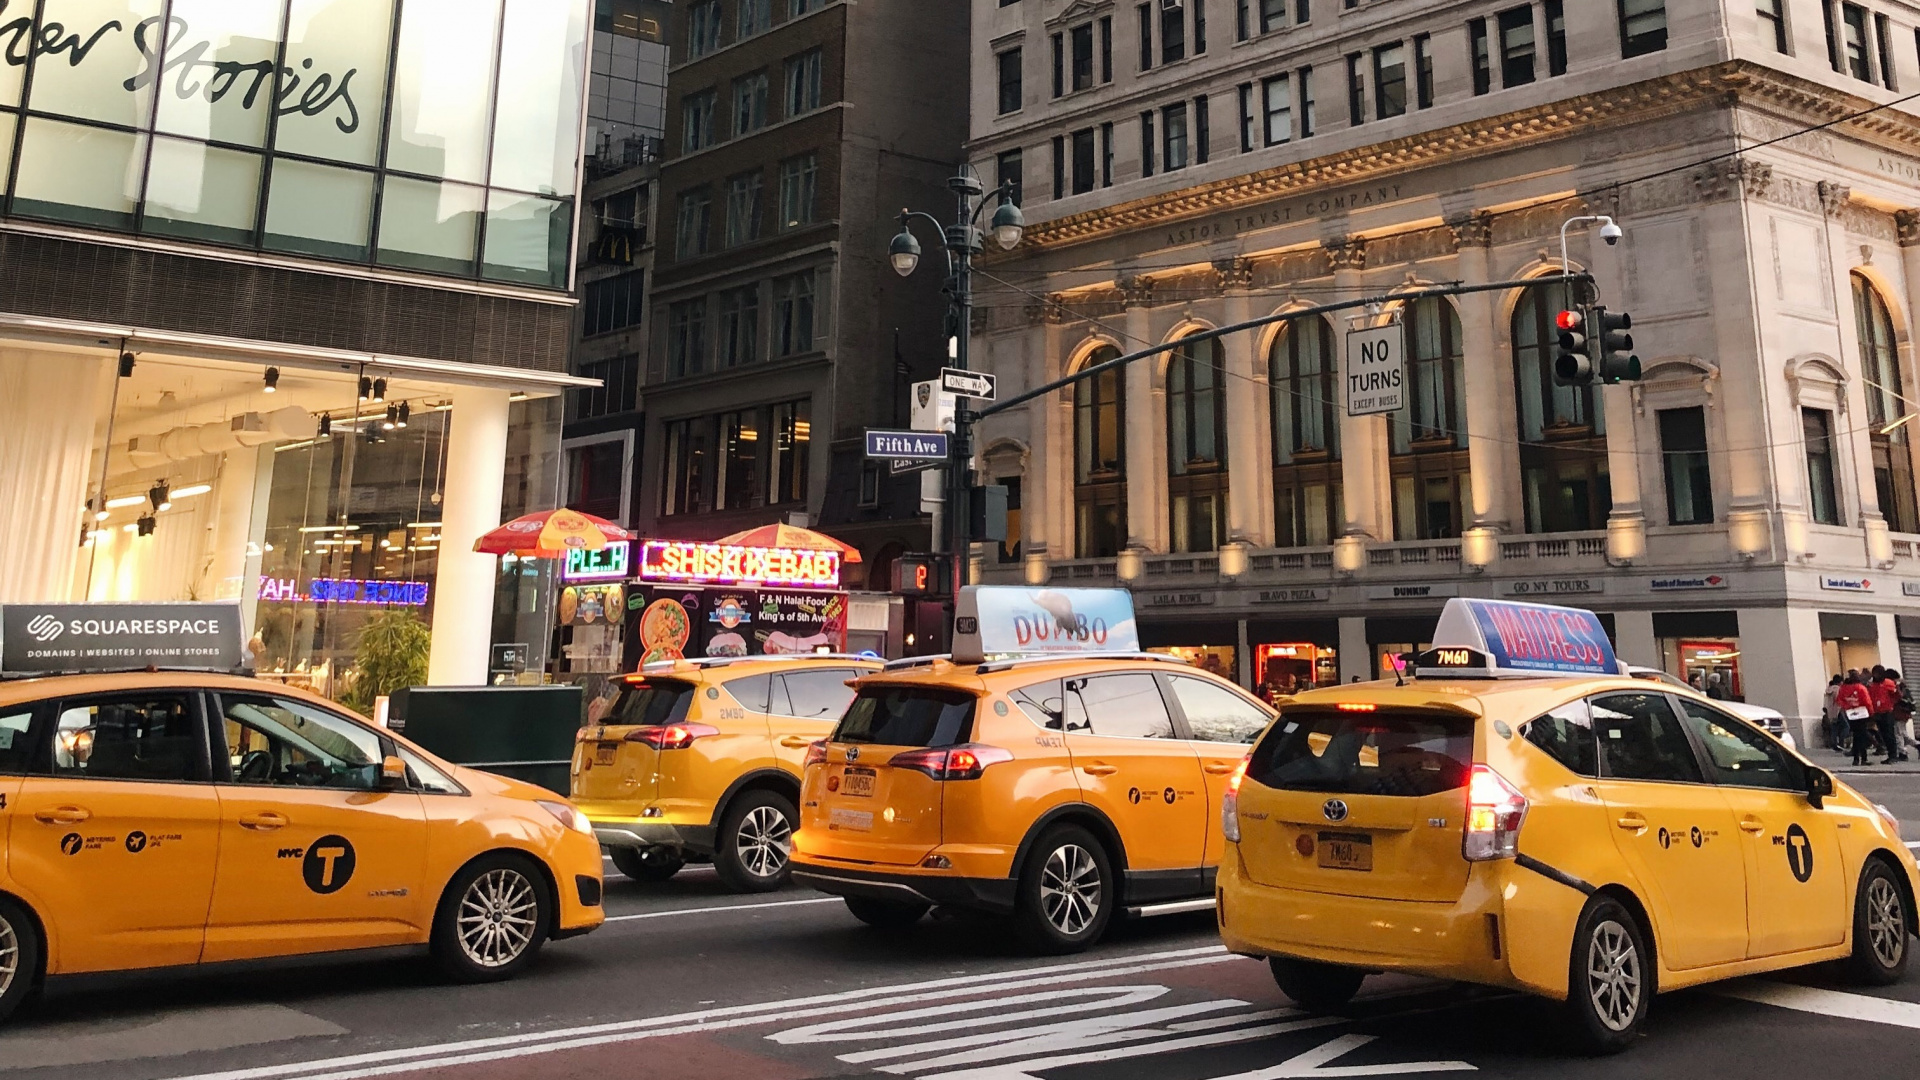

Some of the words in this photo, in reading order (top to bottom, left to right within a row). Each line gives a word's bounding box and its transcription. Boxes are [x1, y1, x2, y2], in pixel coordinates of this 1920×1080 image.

[123, 16, 359, 134] Stories
[1166, 223, 1222, 245] ASTOR
[1305, 185, 1402, 216] COMPANY
[1361, 339, 1389, 365] NO
[949, 376, 965, 388] ONE
[971, 380, 988, 391] WAY
[1350, 368, 1401, 393] TURNS
[1354, 398, 1375, 410] EXCEPT
[1379, 395, 1398, 407] BUSES
[875, 437, 912, 452] Fifth
[914, 438, 937, 453] Ave
[745, 549, 832, 580] KEBAB
[1393, 586, 1431, 597] DUNKIN'
[1513, 582, 1529, 592] GO
[1533, 581, 1549, 592] NY
[1555, 580, 1590, 591] TOURS
[759, 594, 766, 604] F
[776, 596, 782, 605] N
[784, 596, 805, 606] Halal
[806, 597, 827, 607] Food
[1260, 590, 1288, 601] BRAVO
[1290, 589, 1316, 600] PIZZA
[758, 611, 785, 623] King's
[786, 612, 796, 622] of
[797, 612, 810, 622] 5th
[811, 613, 828, 623] Ave
[70, 619, 220, 636] SQUARESPACE
[1484, 603, 1605, 665] WAITRESS
[27, 650, 77, 658] DOMAINS
[86, 648, 136, 657] WEBSITES
[145, 648, 181, 657] ONLINE
[184, 648, 220, 656] STORES
[1437, 650, 1469, 666] 7M60
[277, 847, 304, 859] NYC
